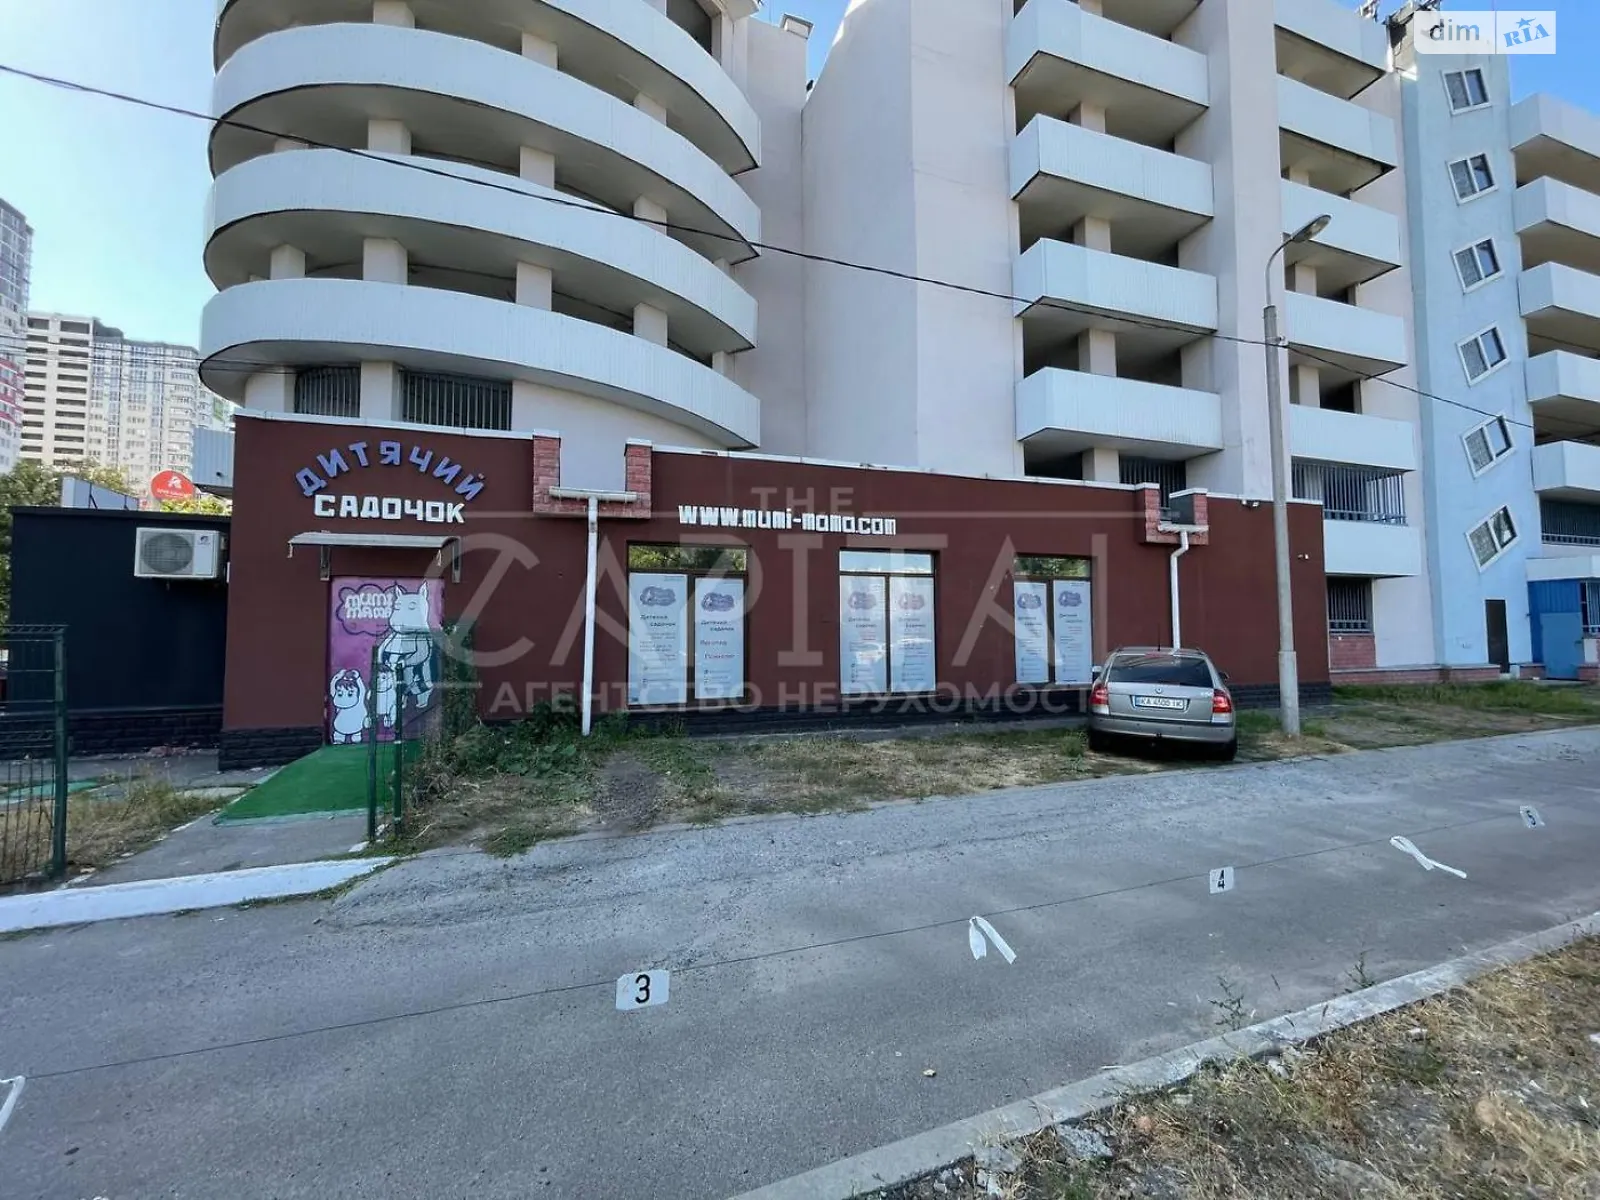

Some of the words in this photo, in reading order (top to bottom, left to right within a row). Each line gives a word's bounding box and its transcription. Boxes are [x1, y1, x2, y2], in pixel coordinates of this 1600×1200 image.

[295, 440, 485, 501] ДИТЯЧИЙ
[314, 494, 465, 524] САДОЧОК
[1217, 869, 1226, 890] 4
[635, 973, 651, 1004] 3
